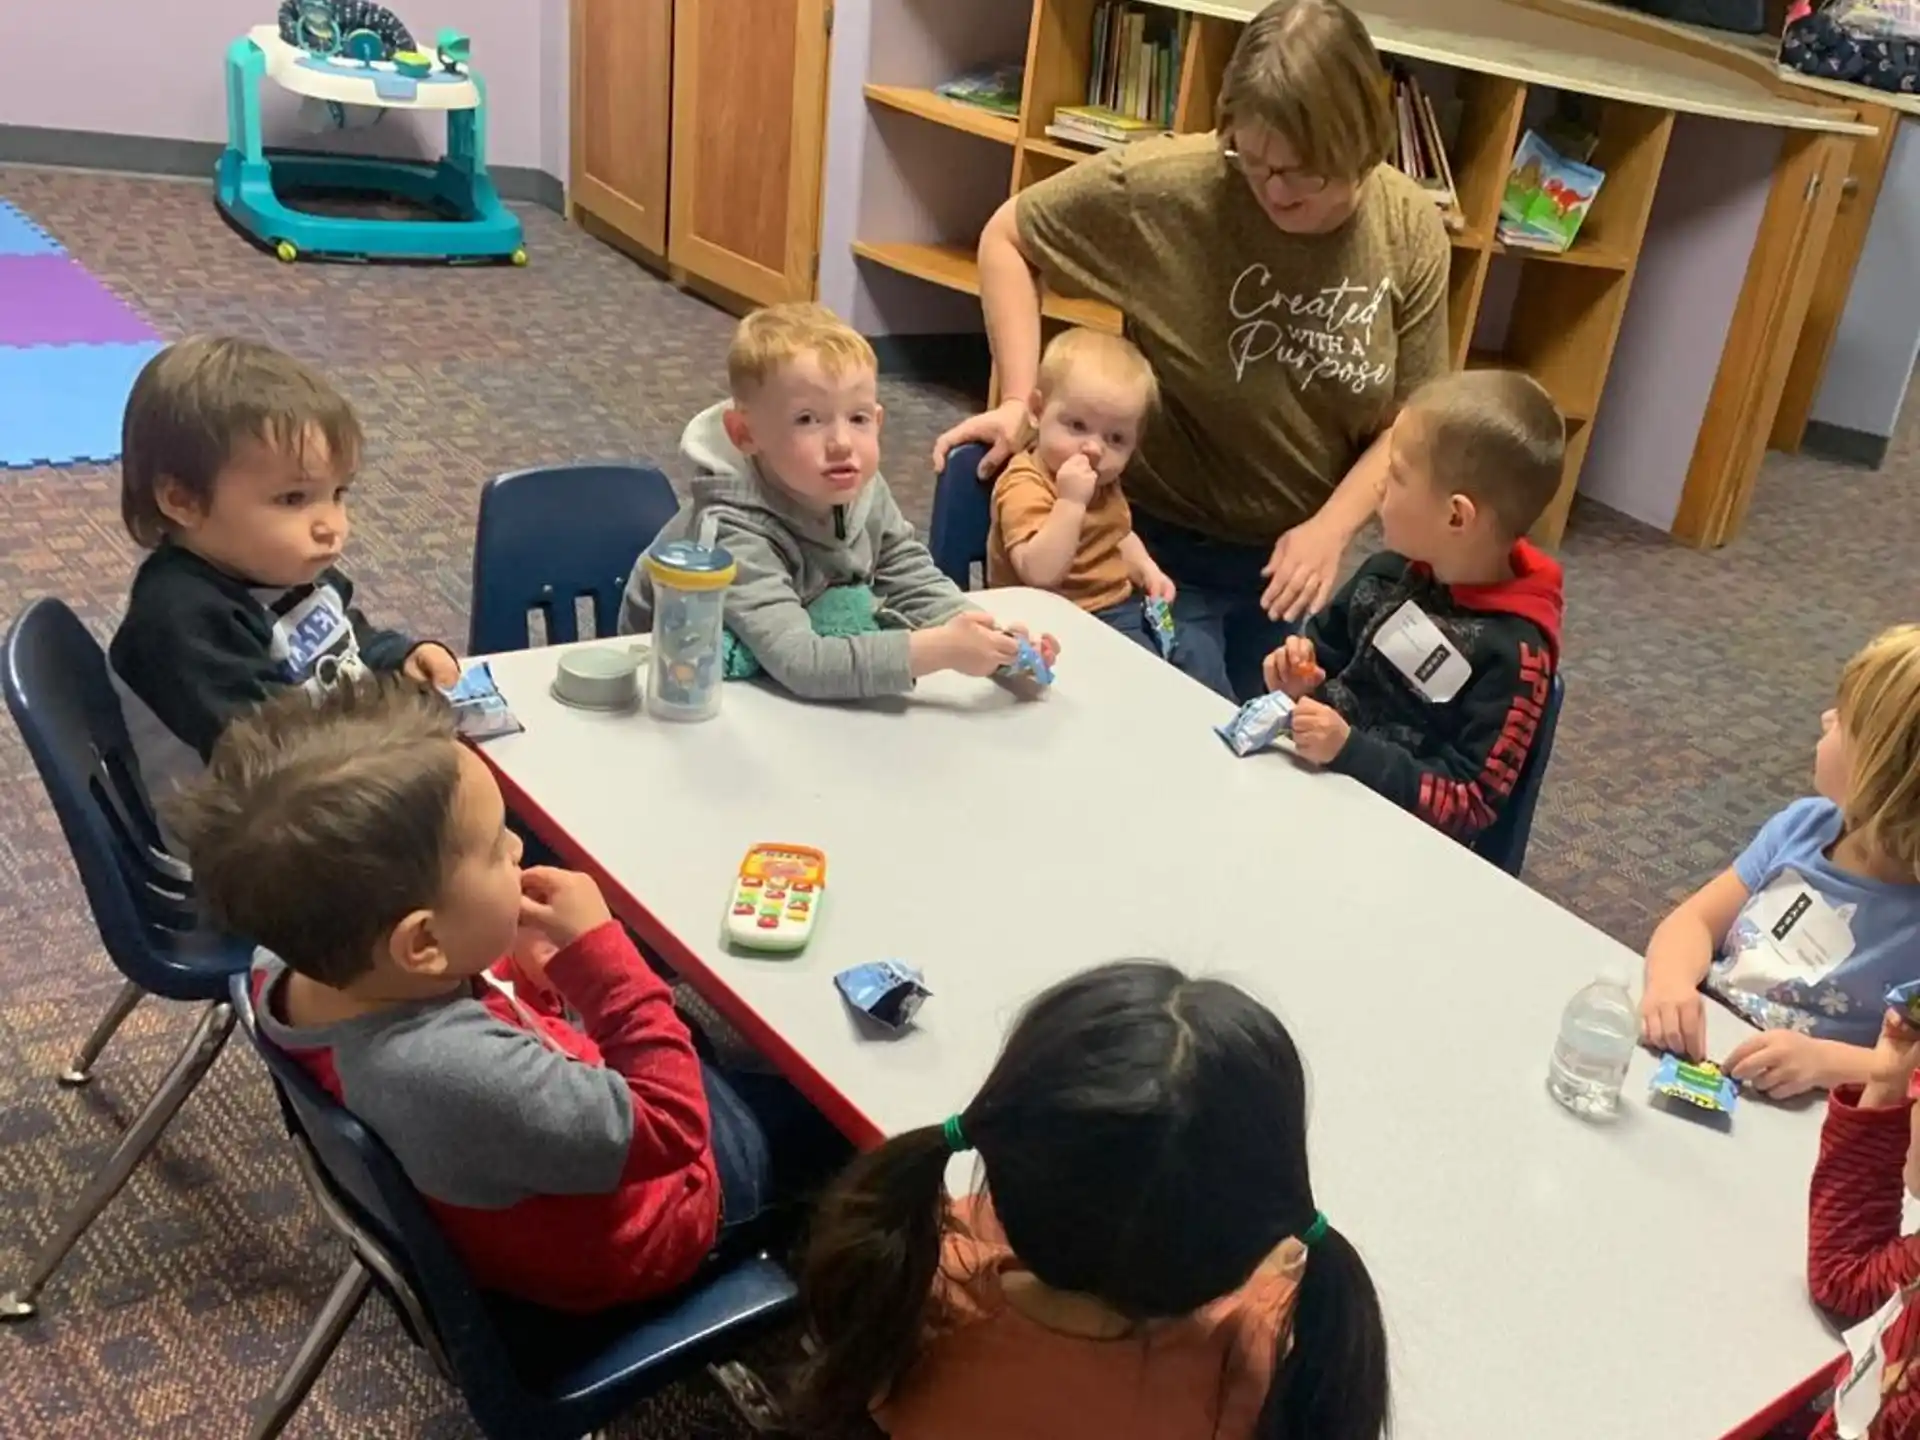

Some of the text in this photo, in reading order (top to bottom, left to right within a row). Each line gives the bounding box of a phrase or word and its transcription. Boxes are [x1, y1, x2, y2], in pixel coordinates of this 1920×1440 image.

[1229, 262, 1391, 345] Created
[1287, 324, 1366, 357] WITH A
[1228, 319, 1392, 393] Purpose
